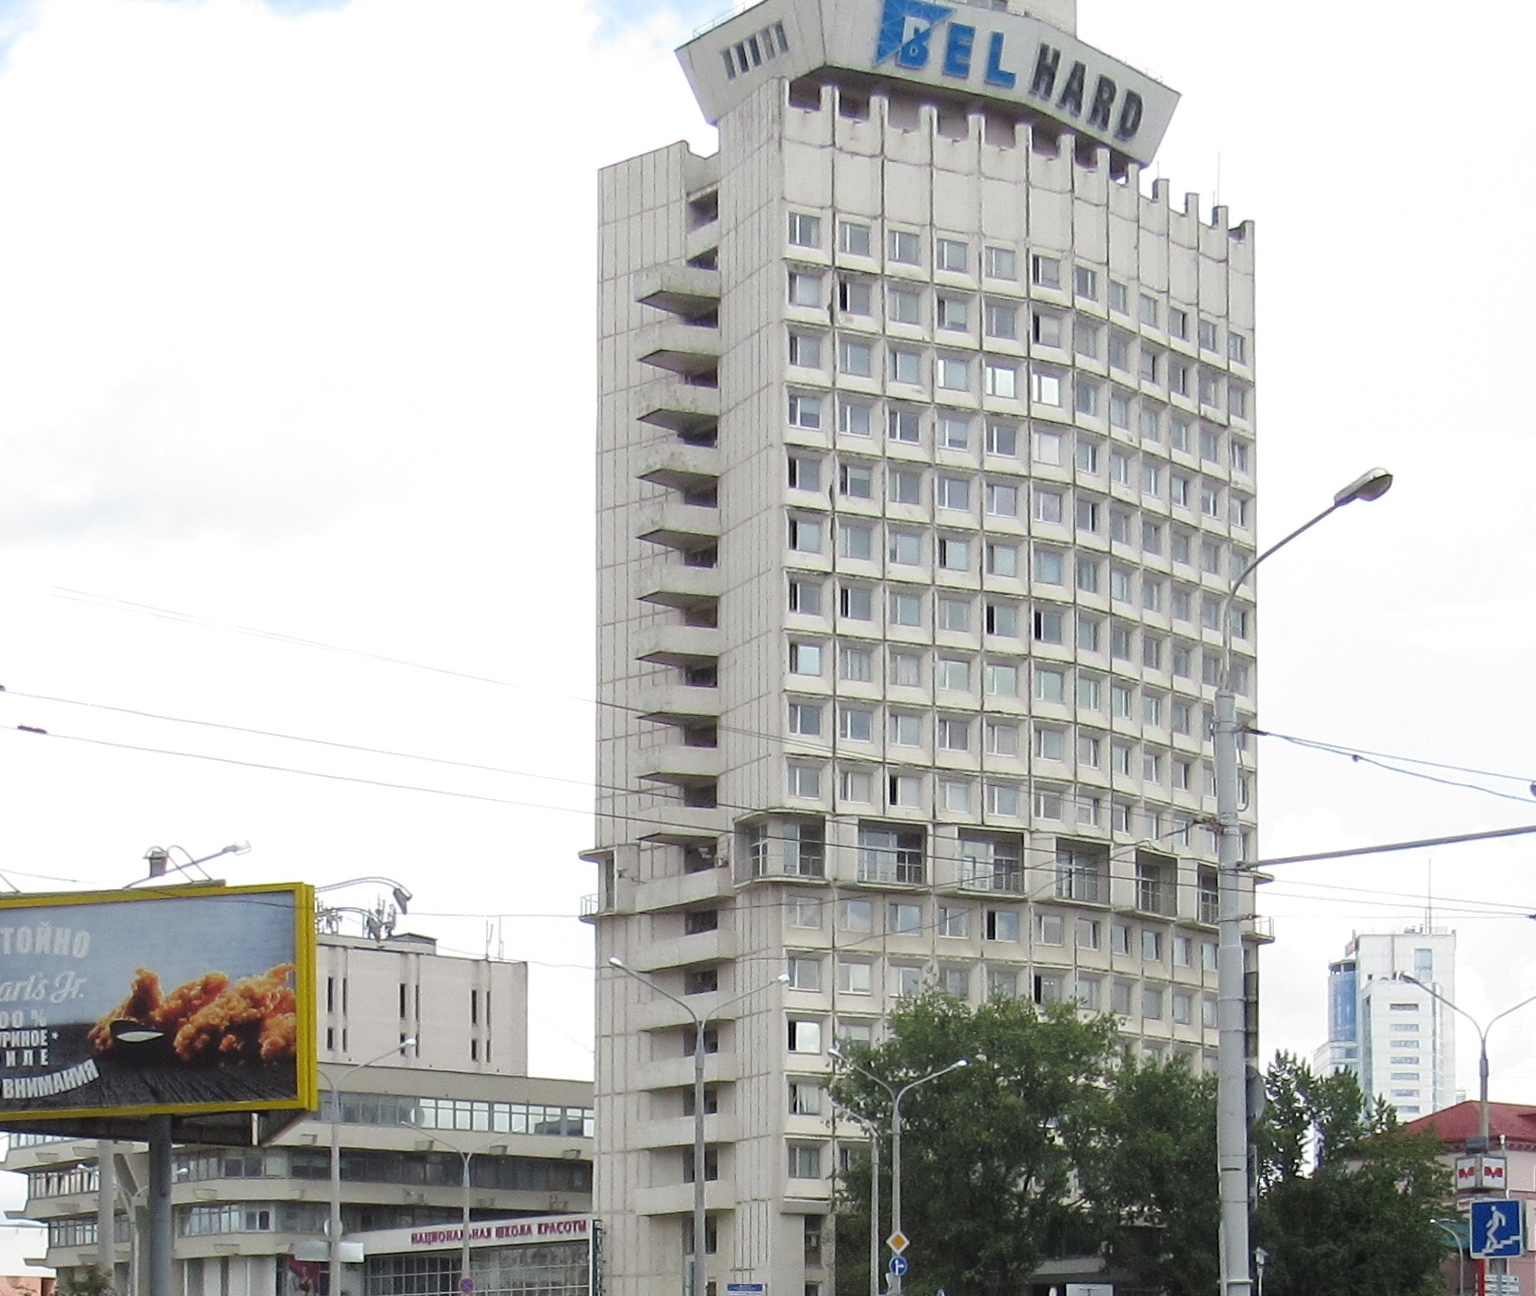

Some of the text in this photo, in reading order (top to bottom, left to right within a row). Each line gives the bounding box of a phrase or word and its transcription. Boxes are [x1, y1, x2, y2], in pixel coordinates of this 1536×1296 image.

[895, 15, 1016, 88] BEL
[1028, 42, 1143, 142] HARD
[2, 1058, 101, 1099] ВНИМАНИЯ
